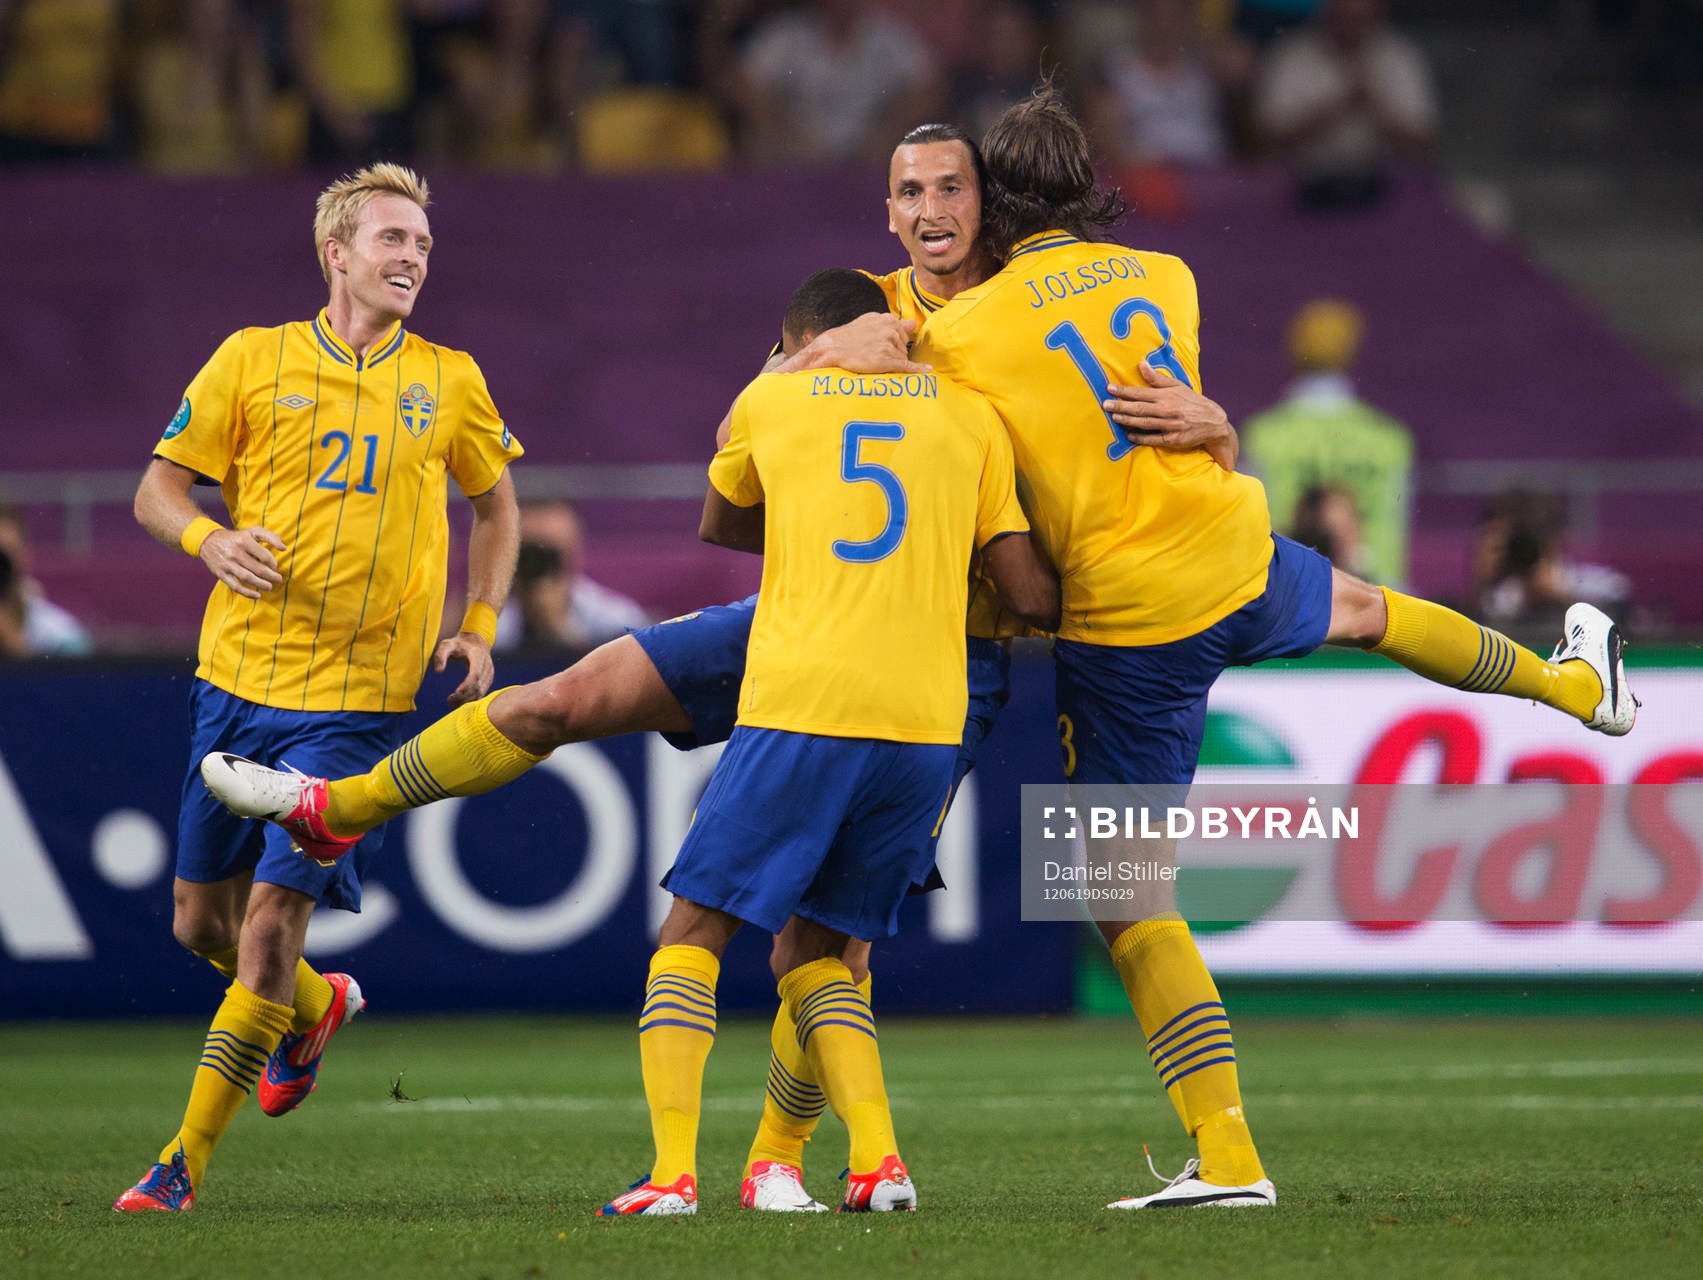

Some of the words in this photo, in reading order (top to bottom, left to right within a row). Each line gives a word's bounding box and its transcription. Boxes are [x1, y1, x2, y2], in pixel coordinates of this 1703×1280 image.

[1025, 256, 1147, 308] J.OLSSON
[811, 374, 938, 400] M.OLSSON
[1045, 297, 1193, 461] 13
[316, 430, 378, 495] 21
[831, 420, 908, 563] 5
